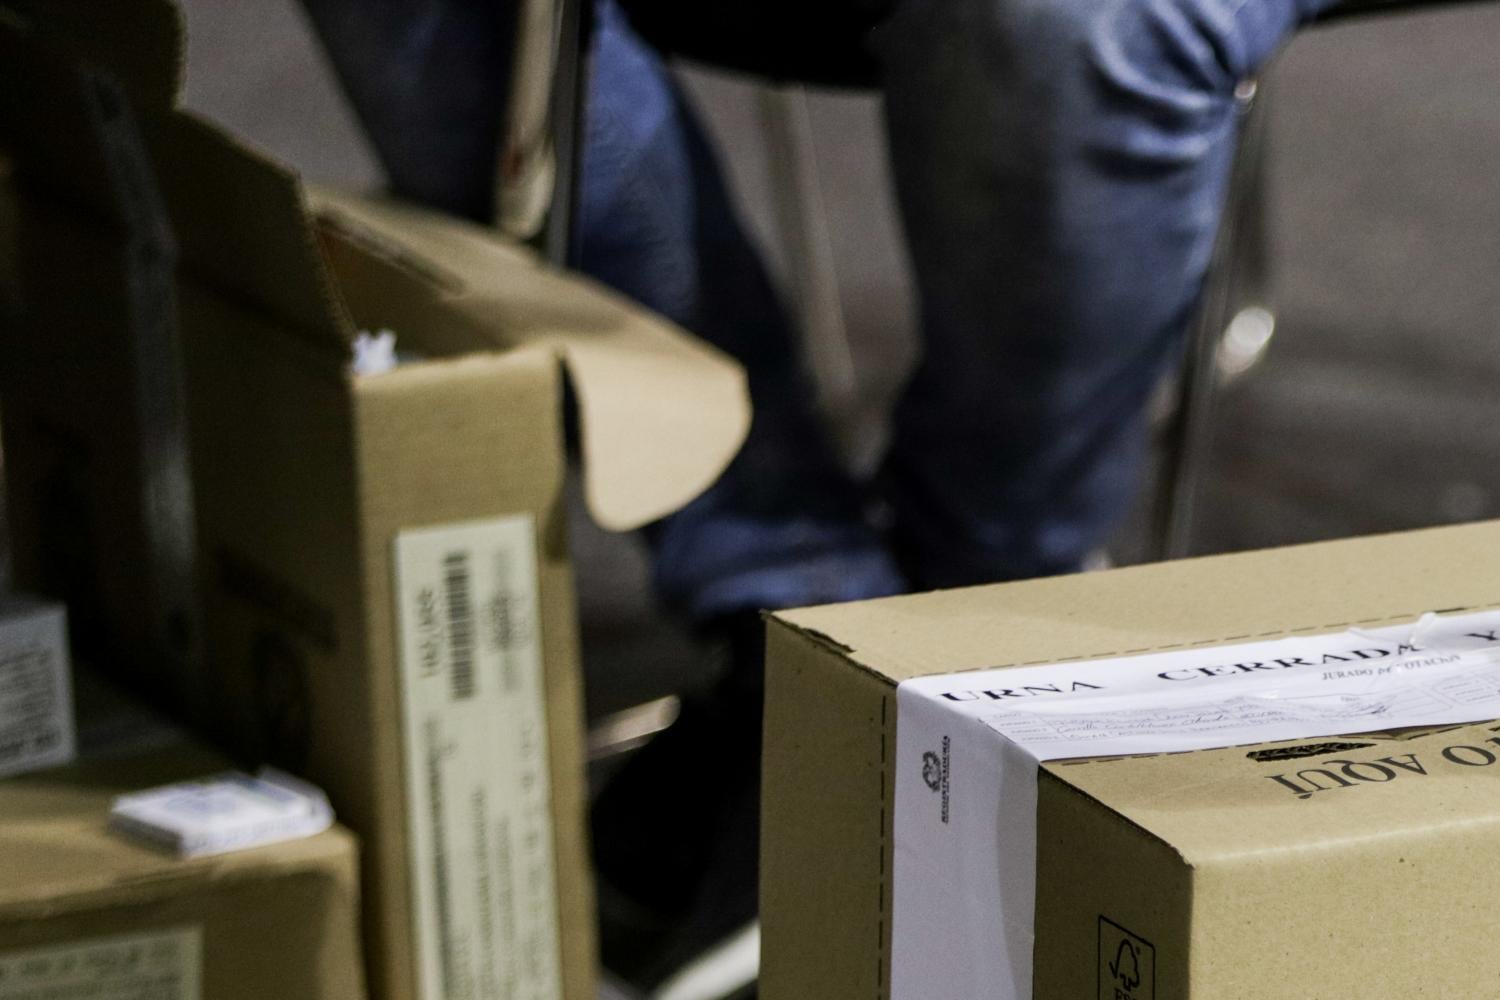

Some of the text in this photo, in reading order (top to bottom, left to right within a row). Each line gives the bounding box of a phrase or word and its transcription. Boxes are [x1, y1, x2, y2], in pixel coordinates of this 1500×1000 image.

[941, 681, 1105, 702] URNA
[1156, 643, 1423, 682] CERRADA
[1463, 629, 1500, 641] Y
[1264, 753, 1428, 799] AQUÍ
